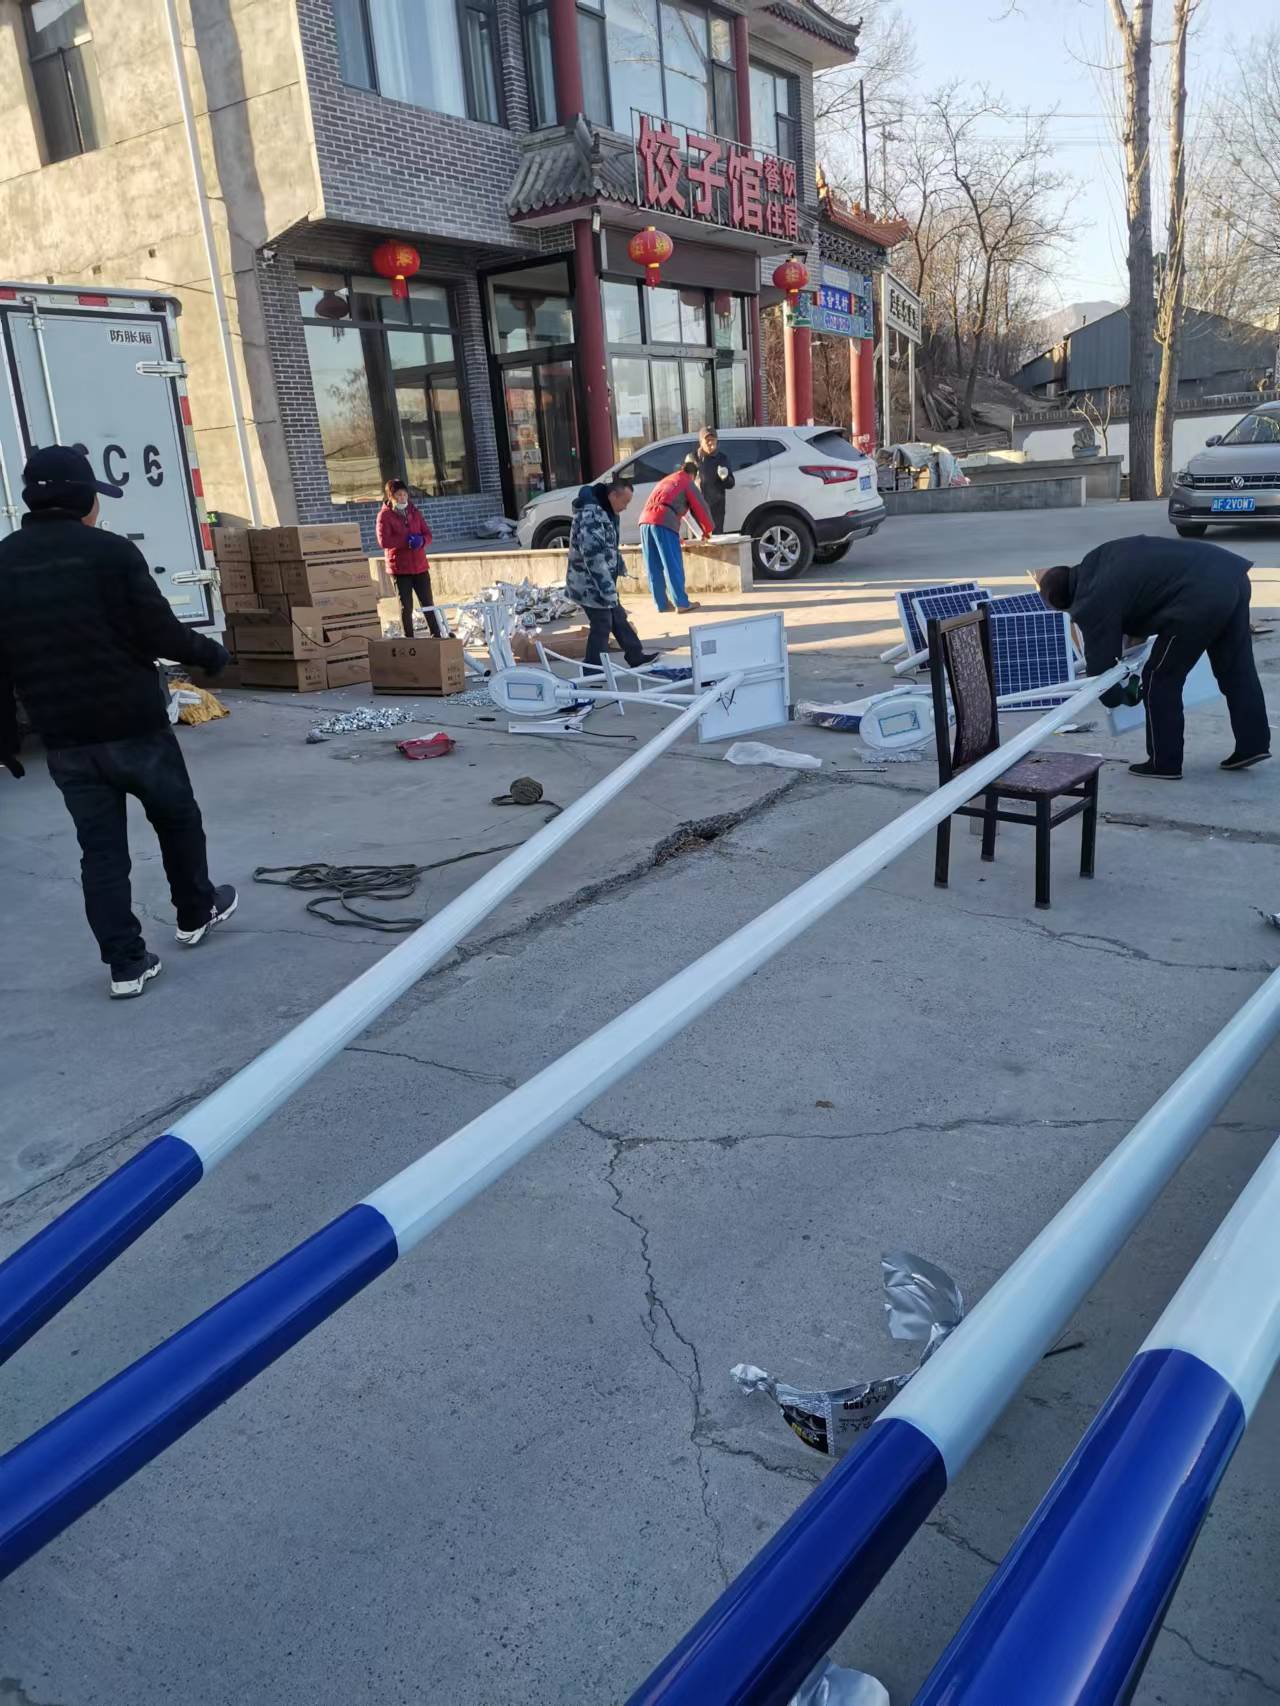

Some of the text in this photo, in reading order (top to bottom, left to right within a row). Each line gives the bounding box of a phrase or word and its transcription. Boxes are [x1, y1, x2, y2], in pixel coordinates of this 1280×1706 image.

[640, 115, 763, 233] 饺子馆
[763, 153, 797, 198] 餐饮
[766, 200, 798, 240] 住宿
